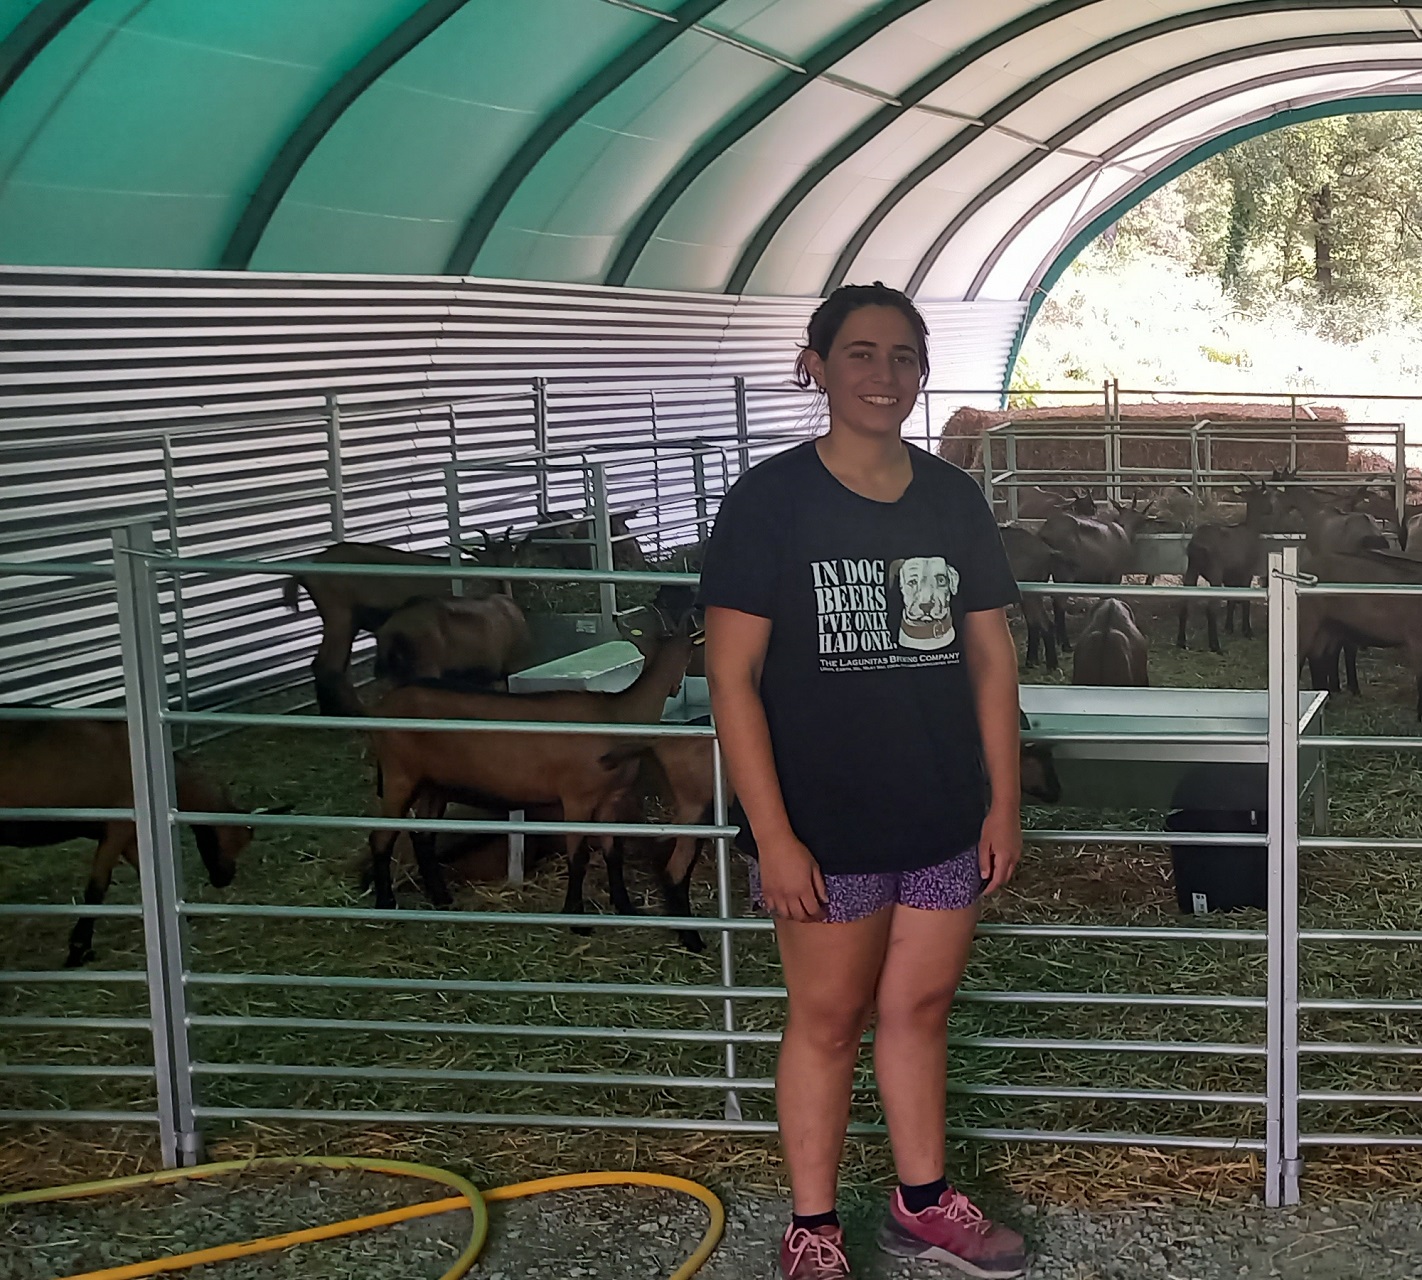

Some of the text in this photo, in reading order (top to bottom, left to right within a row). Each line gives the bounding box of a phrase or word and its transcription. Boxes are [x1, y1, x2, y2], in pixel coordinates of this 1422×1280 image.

[811, 559, 885, 587] IN DOG
[814, 586, 887, 614] BEERS
[817, 612, 888, 633] I'VE ONLY
[818, 631, 898, 654] HAD ONE.
[819, 659, 838, 667] THE
[839, 657, 888, 667] LAGUNITAS
[919, 652, 960, 662] COMPANY
